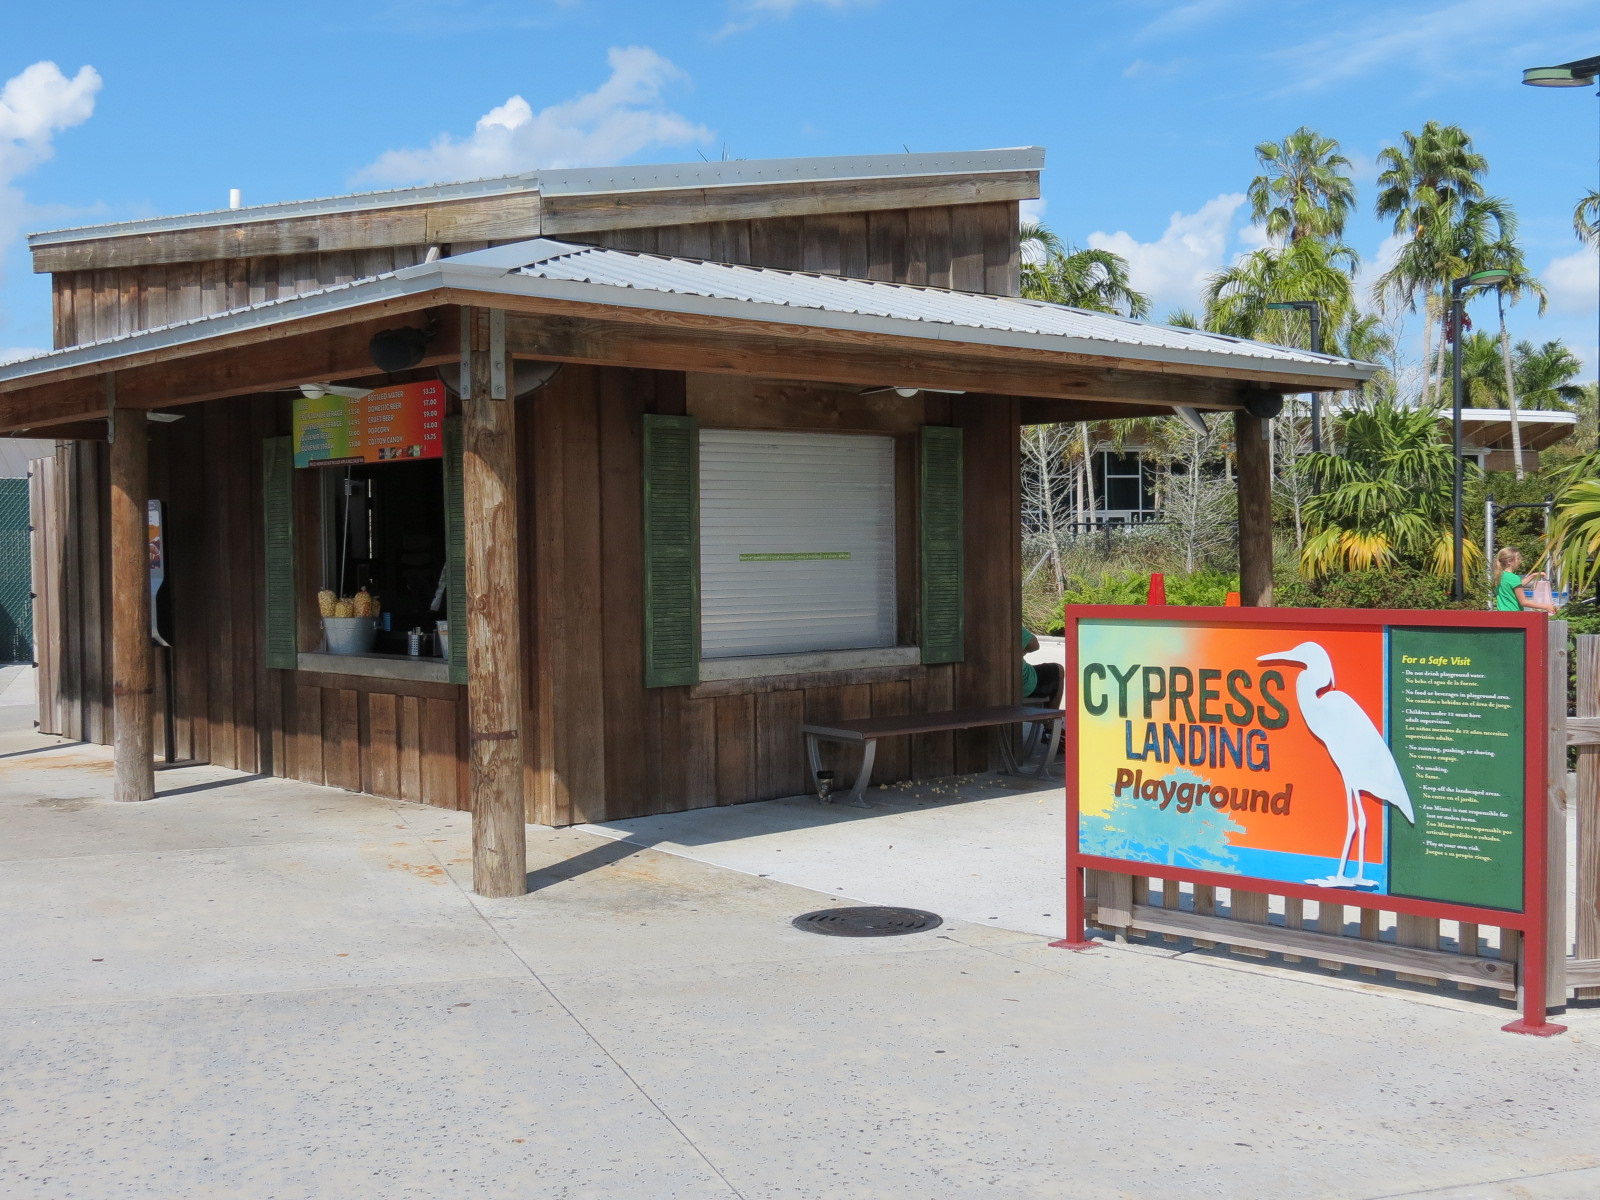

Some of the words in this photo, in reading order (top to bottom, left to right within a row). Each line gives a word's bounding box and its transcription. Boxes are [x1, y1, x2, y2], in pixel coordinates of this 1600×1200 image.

[368, 393, 386, 401] BOTTLED
[1402, 655, 1417, 663] For
[1428, 656, 1448, 666] Safe
[1451, 657, 1471, 665] Visit
[1083, 663, 1289, 730] CYPRESS
[1126, 720, 1270, 771] LANDING
[1115, 768, 1293, 815] Playground
[1469, 809, 1498, 817] responsible
